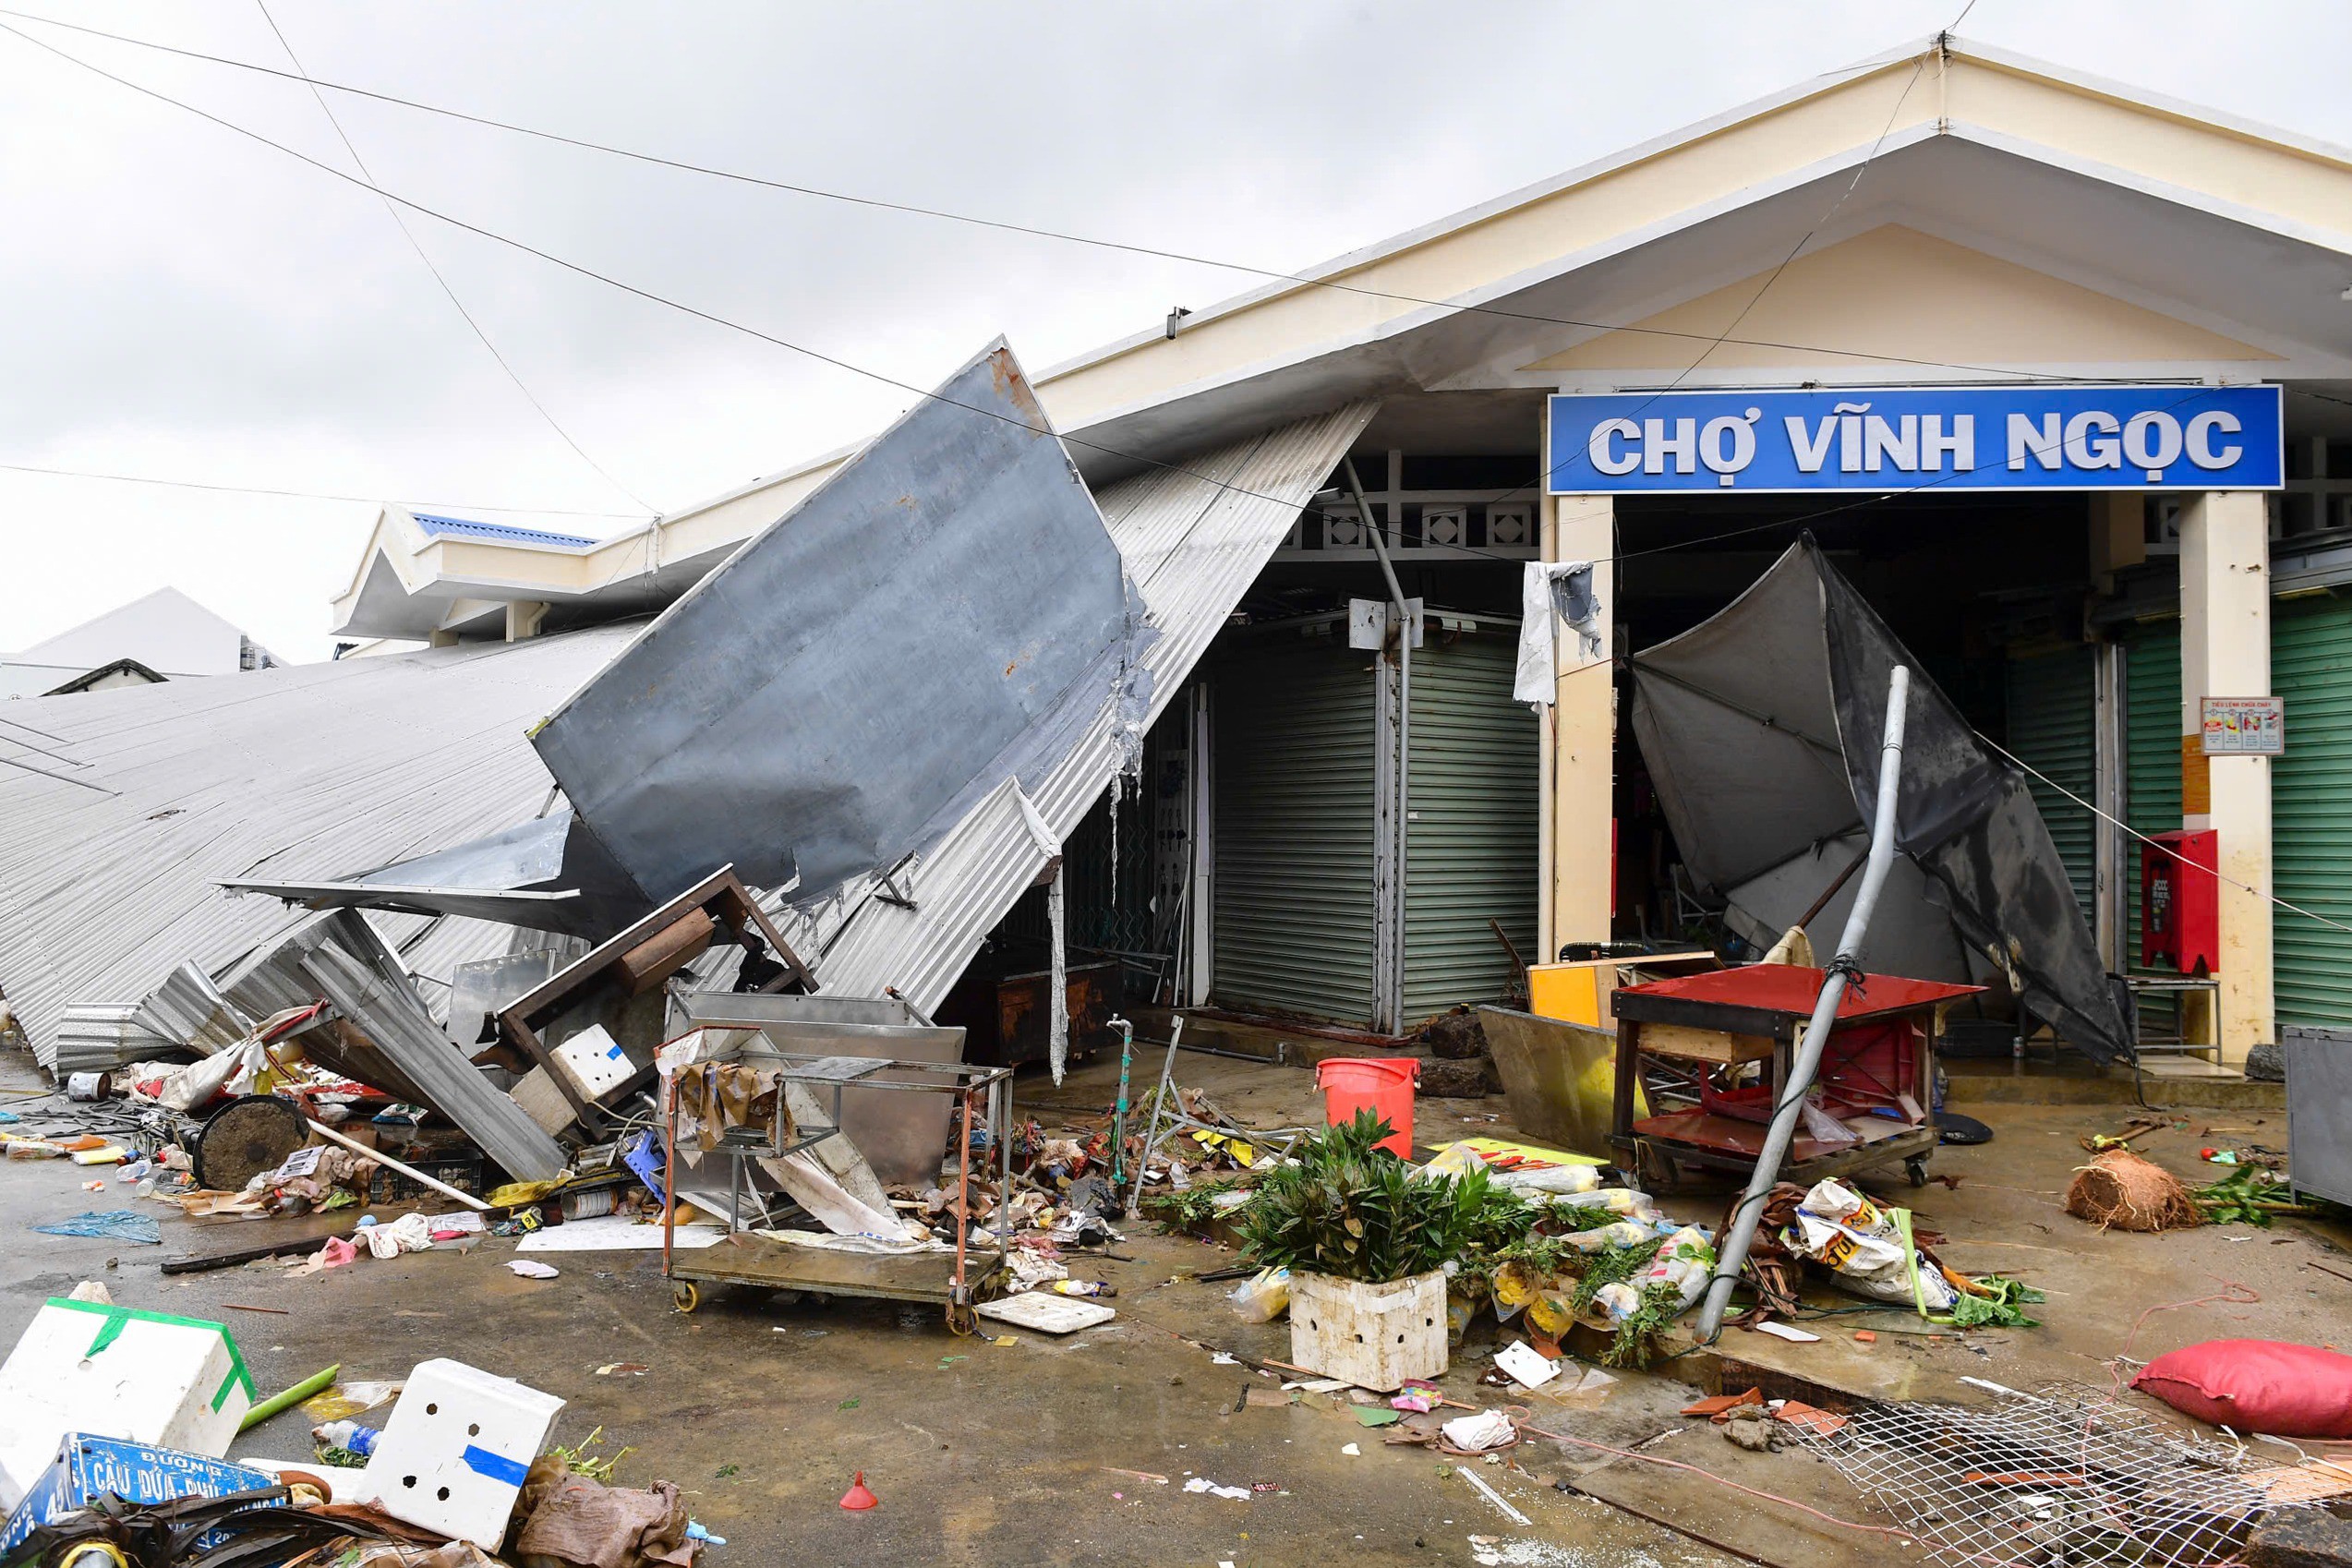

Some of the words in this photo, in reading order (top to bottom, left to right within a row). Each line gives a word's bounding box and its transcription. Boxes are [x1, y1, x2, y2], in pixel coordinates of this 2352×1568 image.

[1588, 406, 1763, 487] CHỢ
[1783, 402, 1975, 474] VĨNH
[2007, 410, 2244, 483] NGỌC
[141, 1452, 223, 1477] ĐƯỜNG
